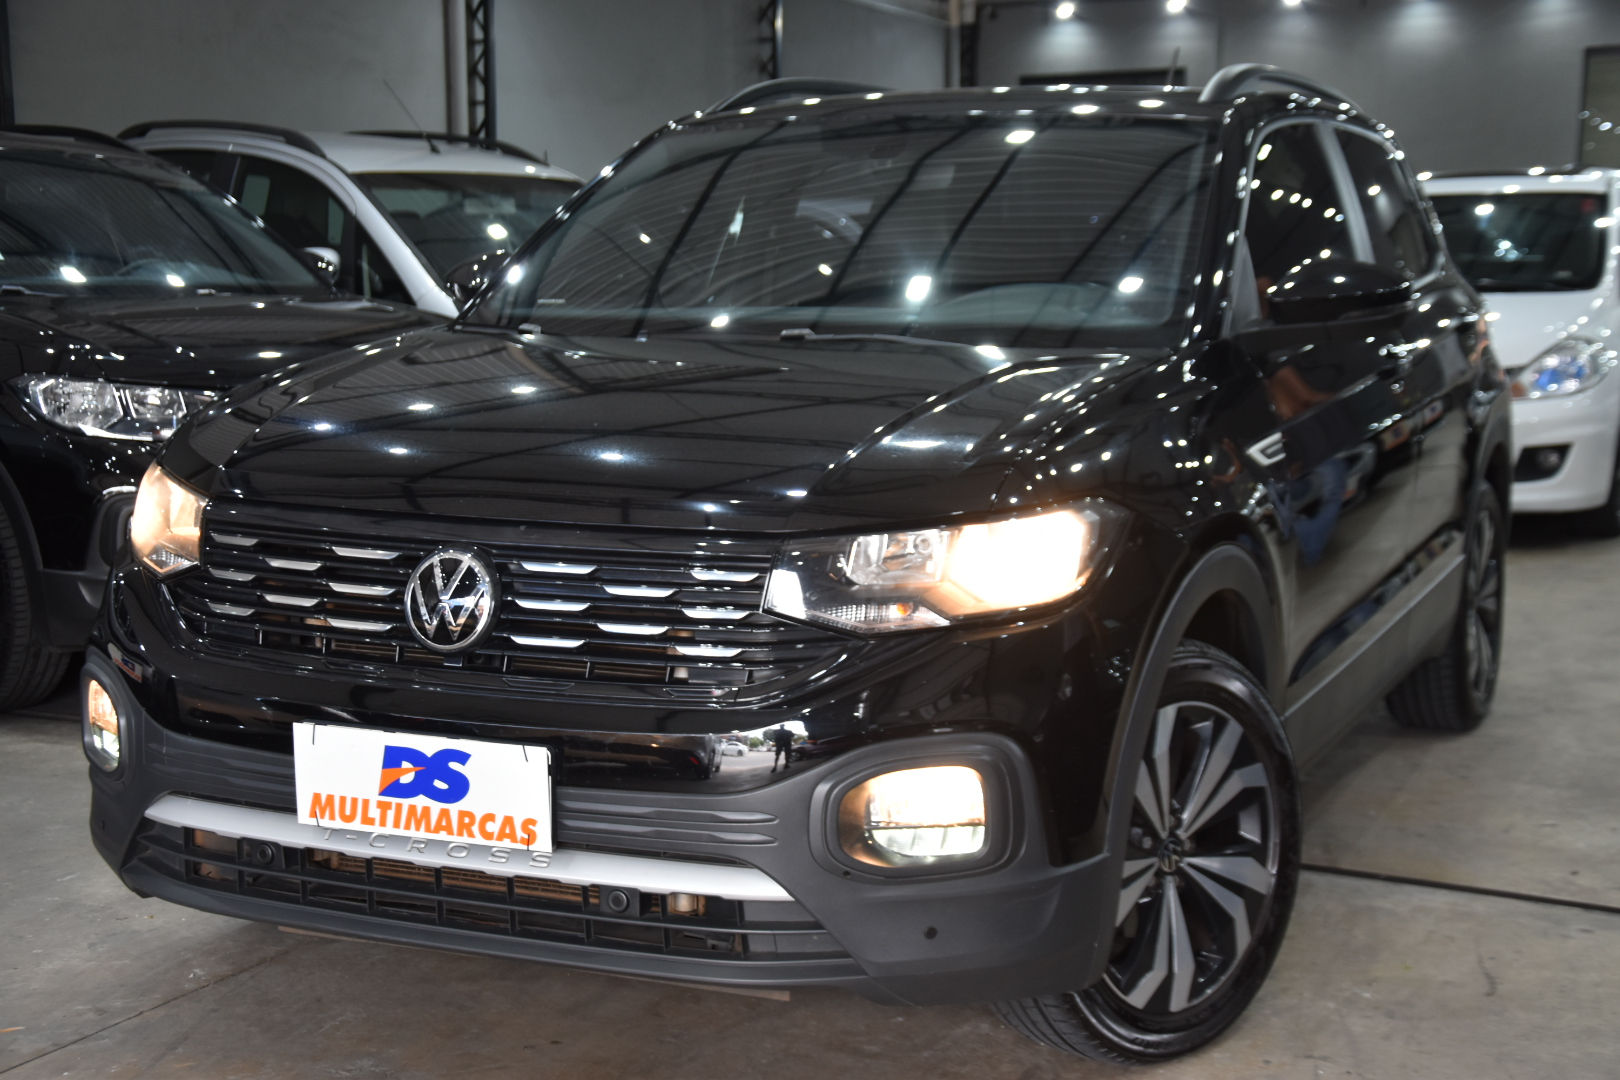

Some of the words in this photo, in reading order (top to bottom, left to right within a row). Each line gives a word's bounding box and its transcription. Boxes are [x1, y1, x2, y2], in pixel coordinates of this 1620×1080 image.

[408, 552, 490, 645] VW
[378, 745, 472, 804] DS
[309, 792, 538, 846] MULTIMARCAS
[322, 828, 553, 869] T-CROSS
